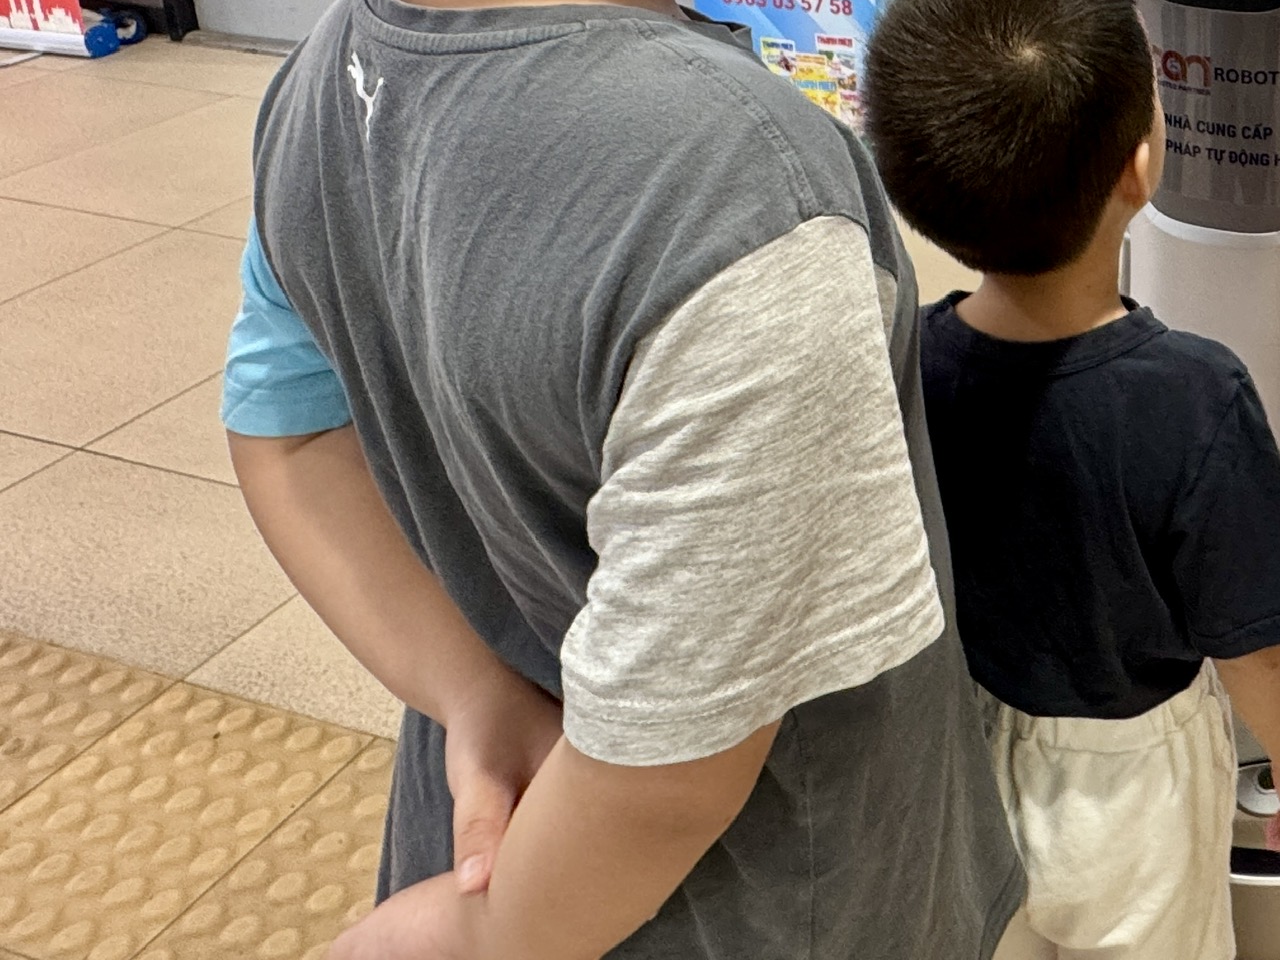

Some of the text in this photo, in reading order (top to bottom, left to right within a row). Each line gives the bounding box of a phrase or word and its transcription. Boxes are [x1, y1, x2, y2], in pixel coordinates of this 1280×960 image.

[1165, 113, 1273, 140] NHÀ CUNG CẤP
[1166, 138, 1201, 157] PHÁP
[1206, 148, 1226, 165] TỰ
[1229, 149, 1270, 167] ĐỘNG
